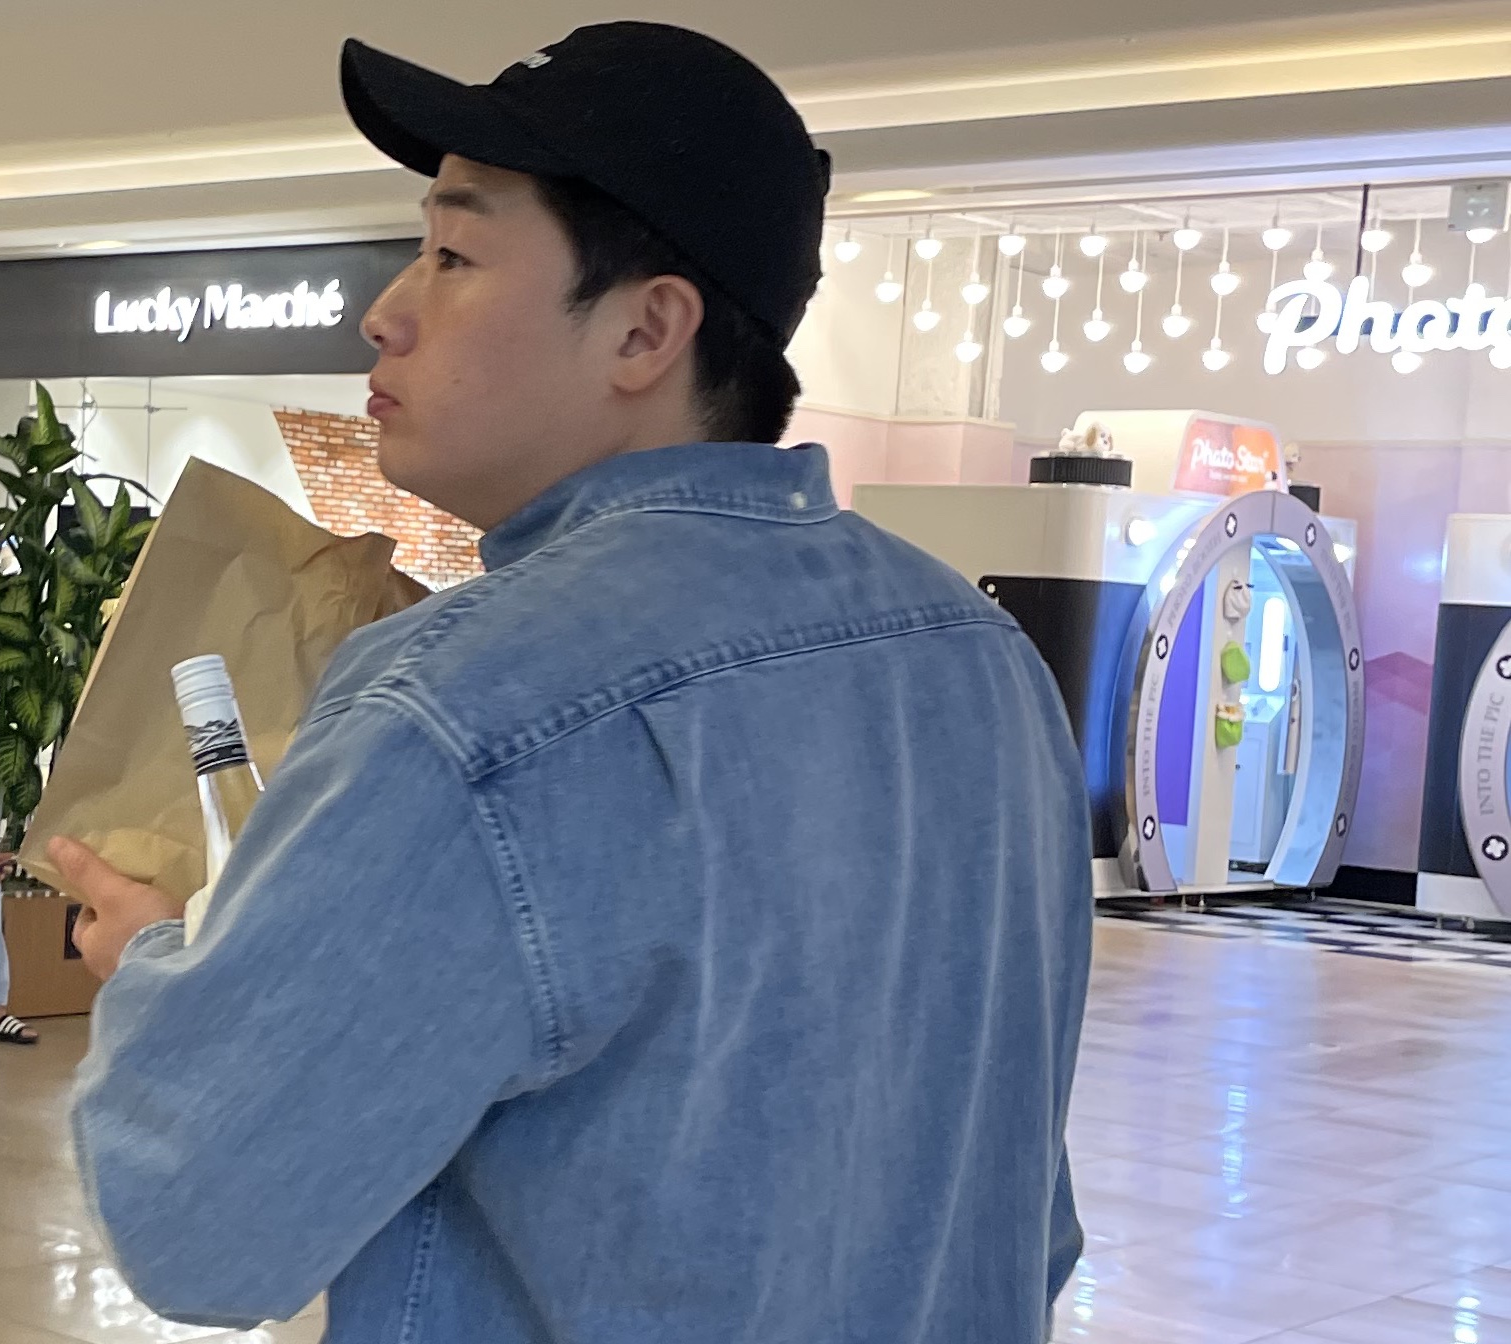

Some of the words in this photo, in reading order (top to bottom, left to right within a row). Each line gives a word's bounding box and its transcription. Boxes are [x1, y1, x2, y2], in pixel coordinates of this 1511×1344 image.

[94, 286, 200, 342] Lucky
[204, 278, 345, 330] Marché
[1190, 437, 1235, 471] Photo
[1486, 692, 1505, 723] PIC
[1478, 722, 1496, 762] THE
[1477, 768, 1494, 817] INTO
